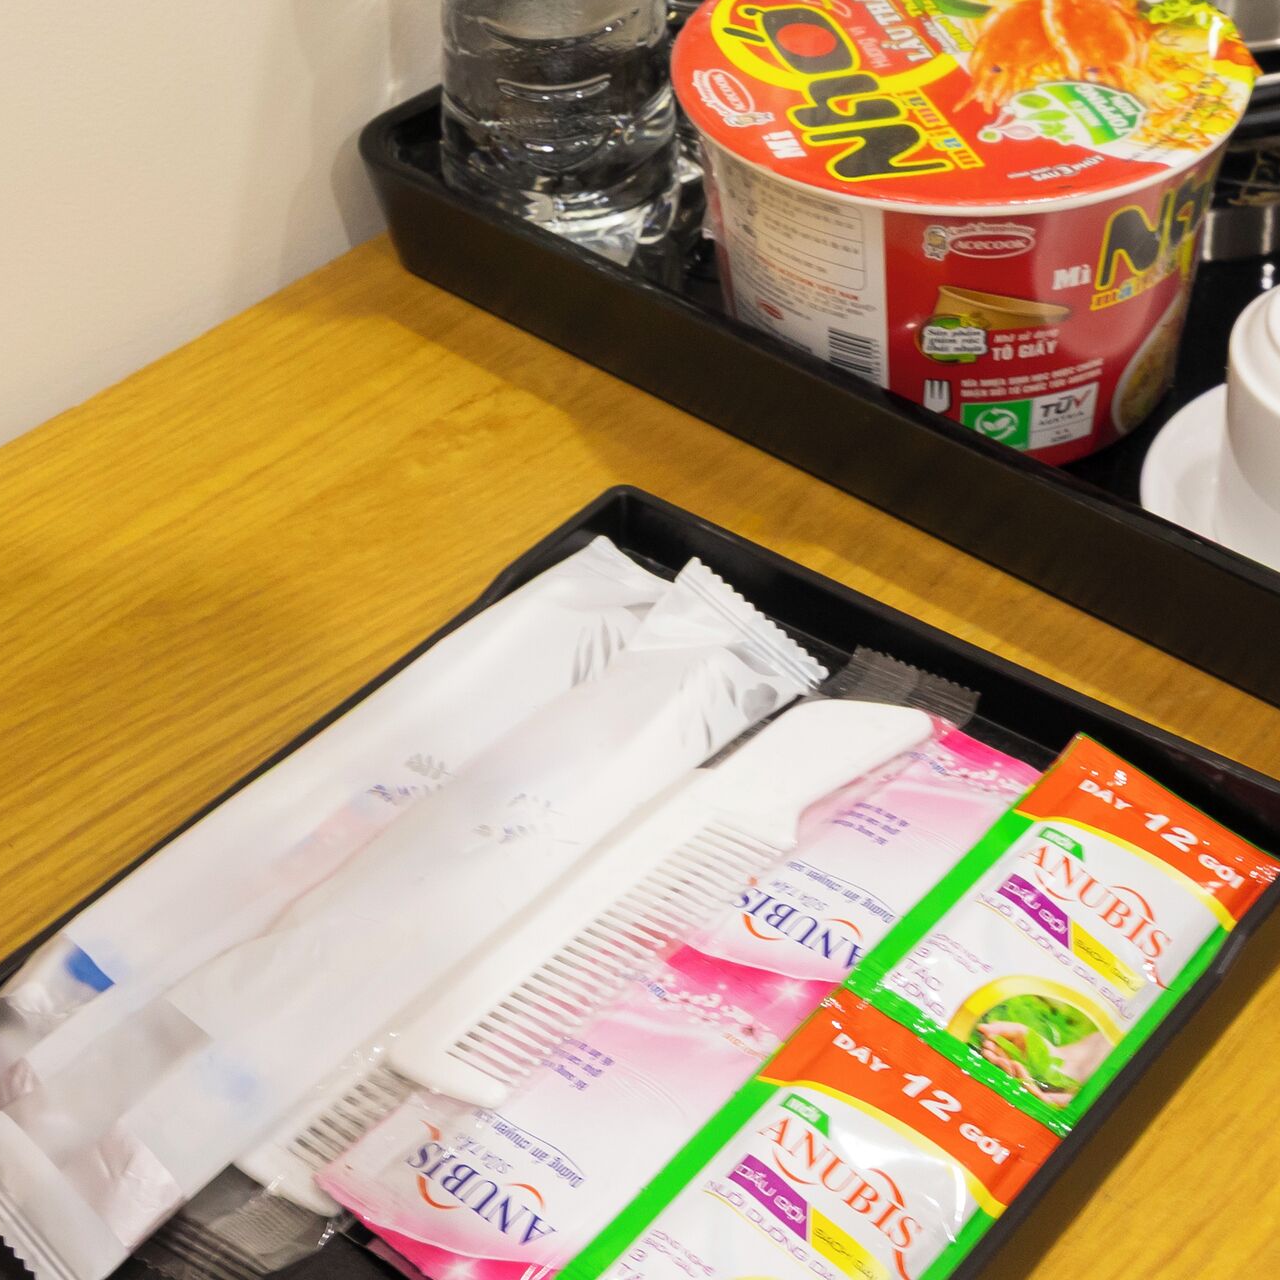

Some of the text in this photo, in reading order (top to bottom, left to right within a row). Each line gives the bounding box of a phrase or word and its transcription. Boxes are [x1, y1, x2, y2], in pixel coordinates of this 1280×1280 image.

[880, 26, 935, 62] LẨU
[762, 130, 808, 160] Mì
[954, 239, 1028, 251] ACECOOK
[1052, 264, 1092, 291] Mì
[1144, 811, 1201, 854] 12
[1019, 845, 1174, 959] ANUBIS
[731, 886, 866, 970] ANUBIS
[900, 1068, 965, 1123] 12
[957, 1120, 1013, 1166] GÓI
[405, 1140, 559, 1247] ANUBIS
[734, 1163, 777, 1197] DẦU
[758, 1117, 924, 1250] ANUBIS
